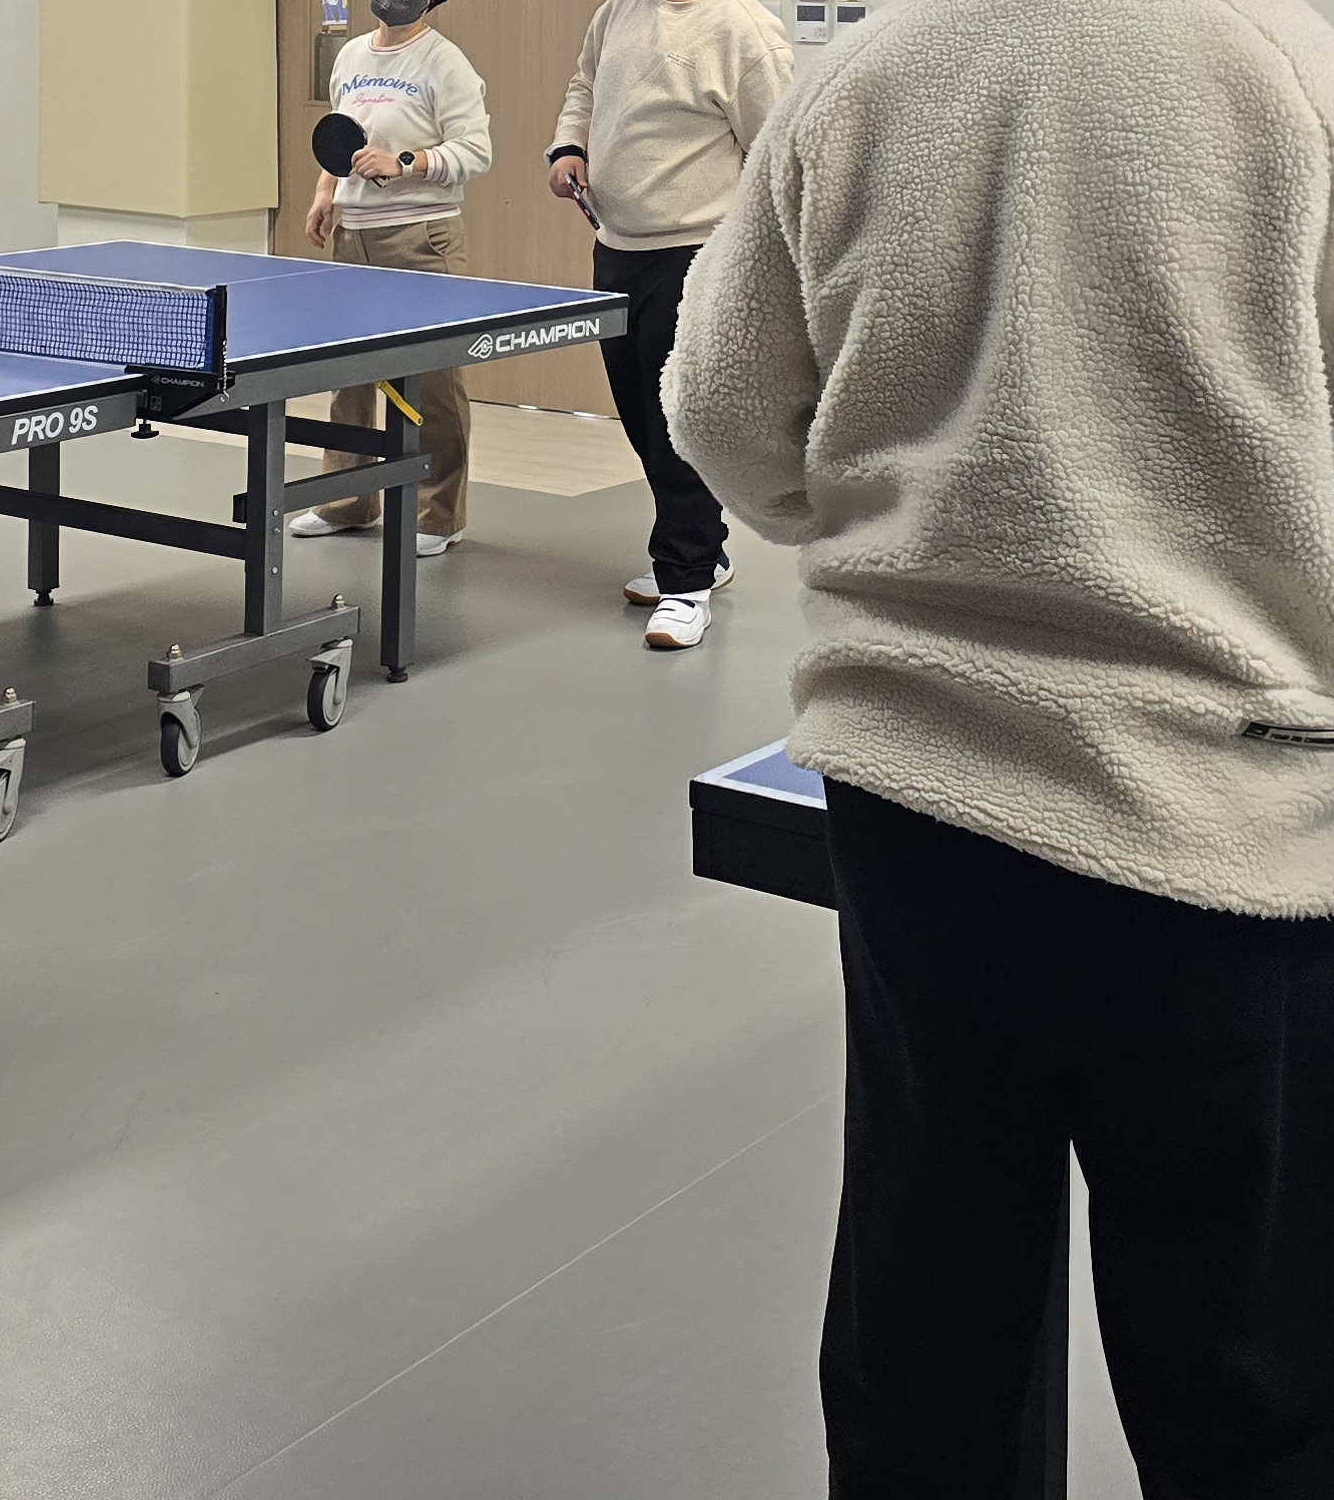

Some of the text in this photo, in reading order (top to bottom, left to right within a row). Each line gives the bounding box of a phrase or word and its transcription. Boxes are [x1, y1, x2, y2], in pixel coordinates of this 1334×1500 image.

[342, 74, 418, 96] Mémoire
[495, 318, 600, 352] CHAMPION
[161, 378, 205, 388] CHAMPION
[11, 405, 99, 445] PRO 9S
